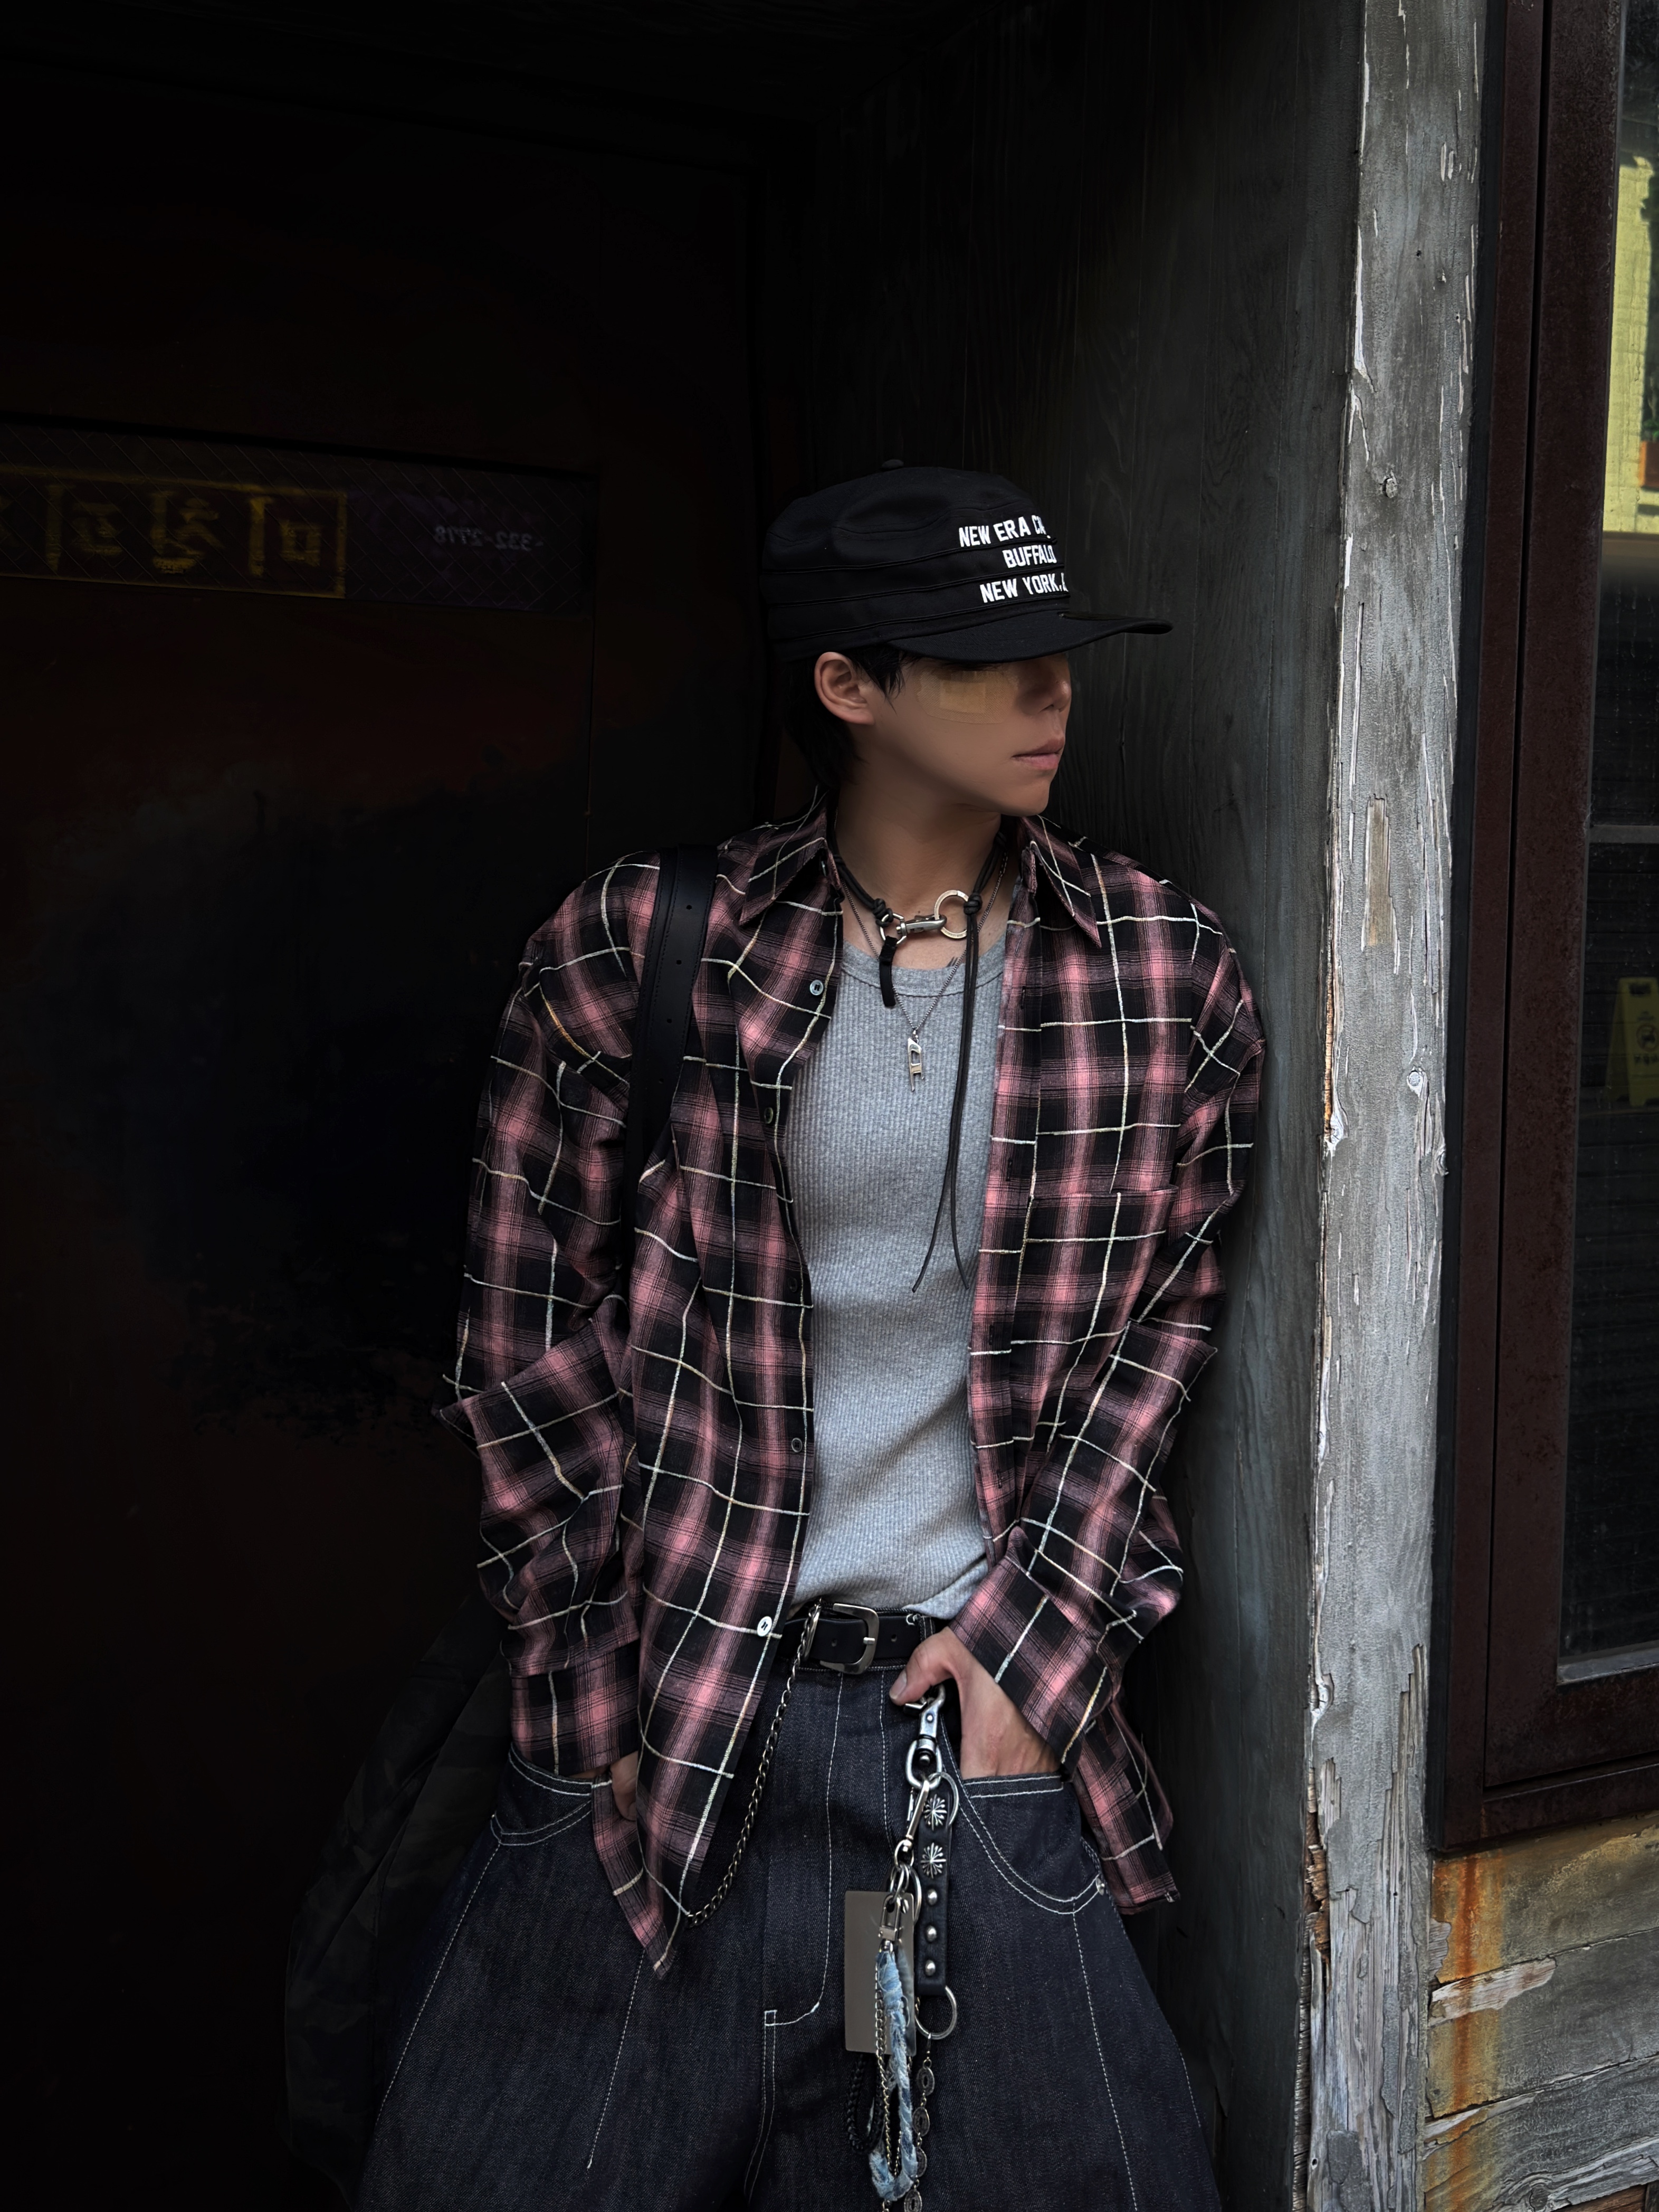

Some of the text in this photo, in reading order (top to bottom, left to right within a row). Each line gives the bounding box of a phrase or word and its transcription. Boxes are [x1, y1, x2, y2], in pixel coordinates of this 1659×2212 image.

[958, 525, 991, 547] NEW
[993, 516, 1032, 542] ERA
[1002, 544, 1057, 568] BUFFALO
[979, 578, 1018, 603] NEW
